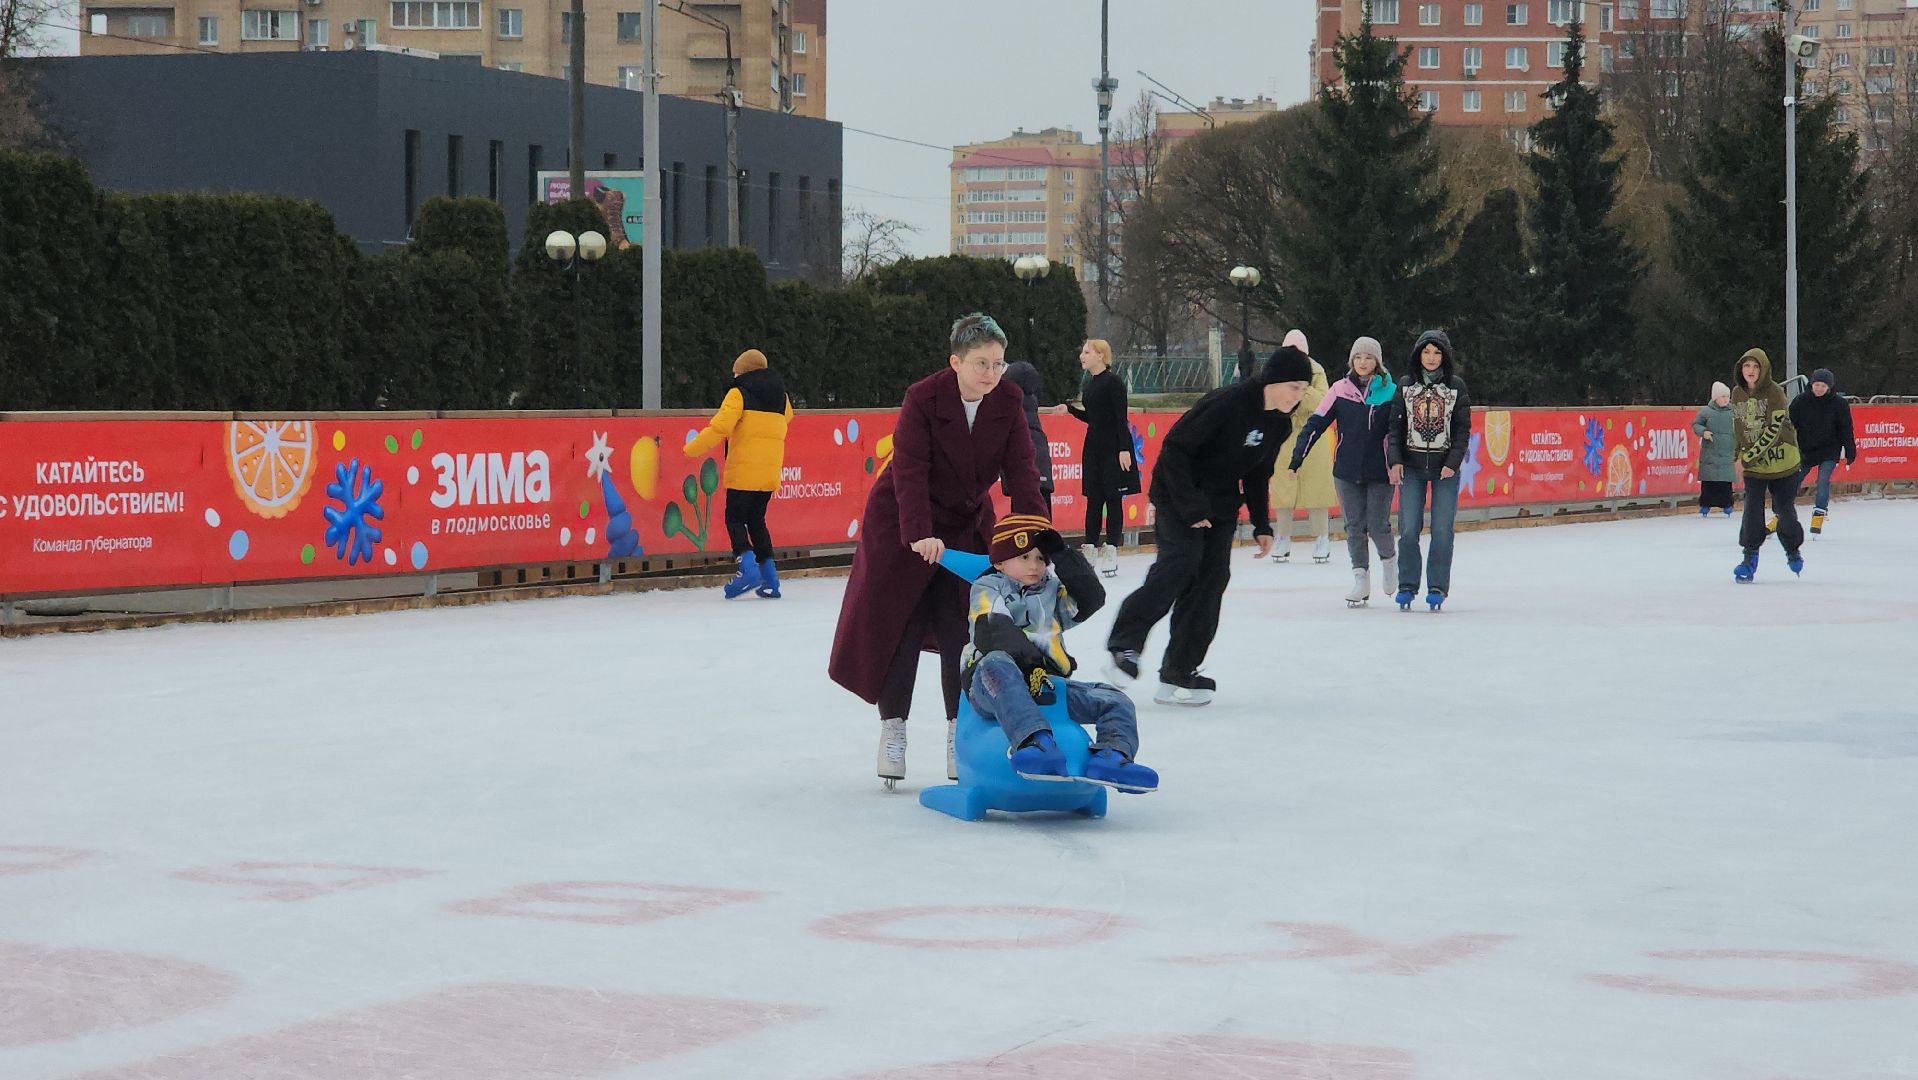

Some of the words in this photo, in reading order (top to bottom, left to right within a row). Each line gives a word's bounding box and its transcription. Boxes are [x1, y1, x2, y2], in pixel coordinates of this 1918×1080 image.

[36, 456, 145, 484] КАТАЙТЕСЬ
[12, 491, 184, 520] УДОВОЛЬСТВИЕМ!
[431, 519, 441, 535] в
[445, 513, 551, 536] подмосковье
[33, 538, 82, 553] Команда
[84, 535, 153, 554] губернатора
